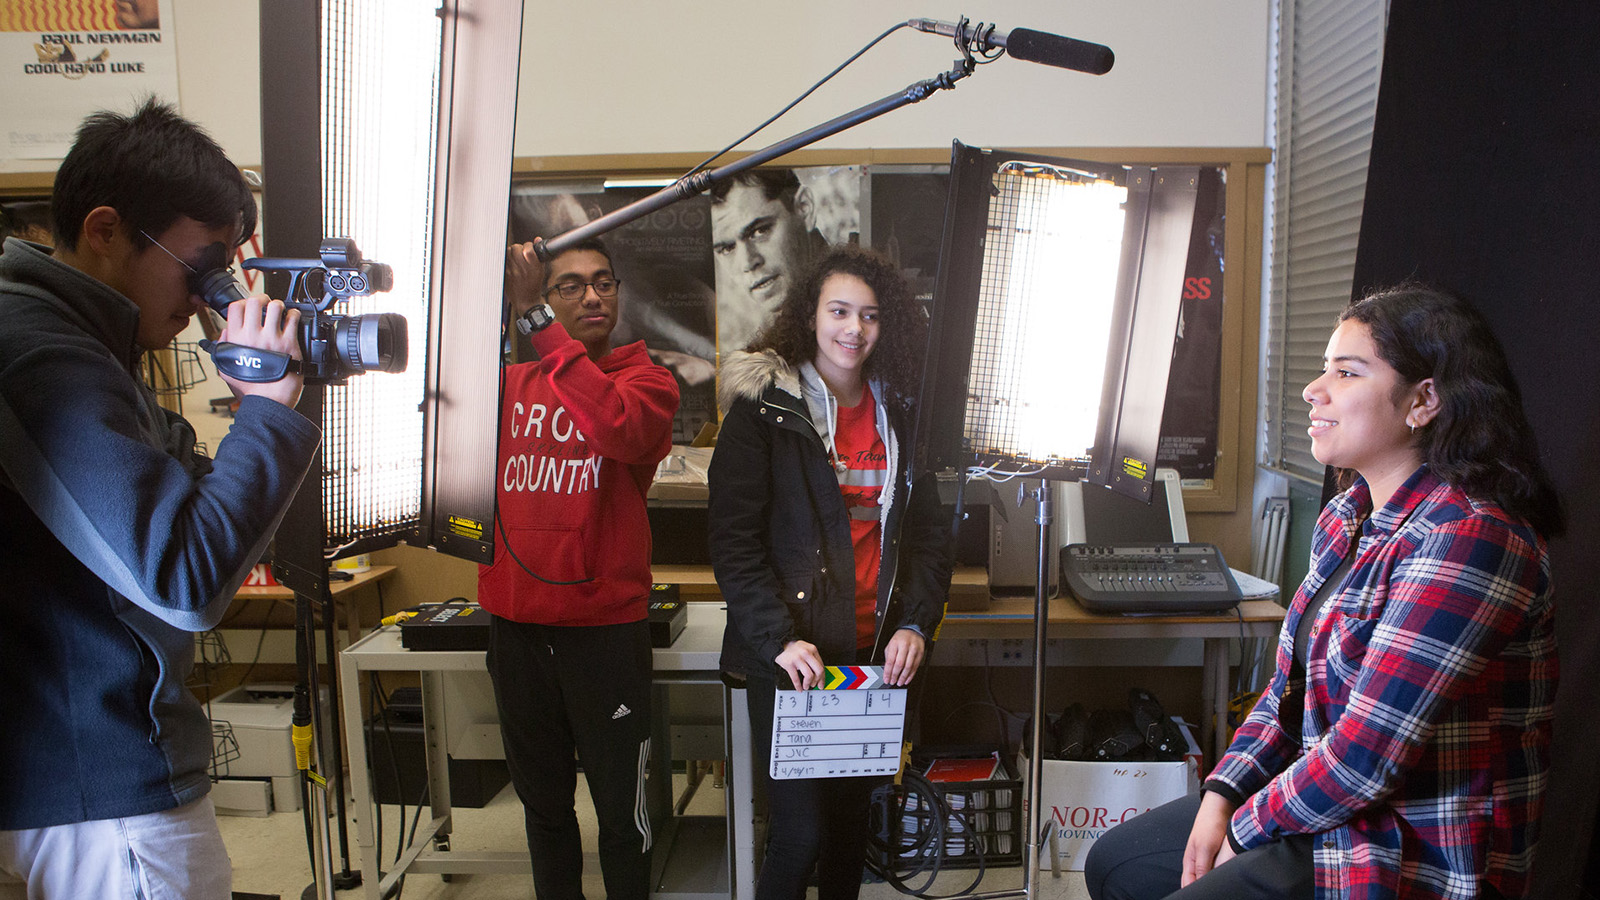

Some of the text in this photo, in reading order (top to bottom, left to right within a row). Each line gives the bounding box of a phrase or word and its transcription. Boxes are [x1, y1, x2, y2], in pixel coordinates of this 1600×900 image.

[41, 32, 162, 44] PAUL NEWMAN
[24, 63, 61, 74] COOL
[110, 62, 146, 73] LUKE
[235, 356, 262, 369] JVC
[503, 454, 603, 495] COUNTRY
[790, 696, 797, 708] 3
[821, 693, 840, 707] 23
[881, 693, 891, 708] 4
[790, 719, 823, 728] Steven
[785, 747, 810, 758] JVC
[1051, 805, 1151, 829] NOR-C
